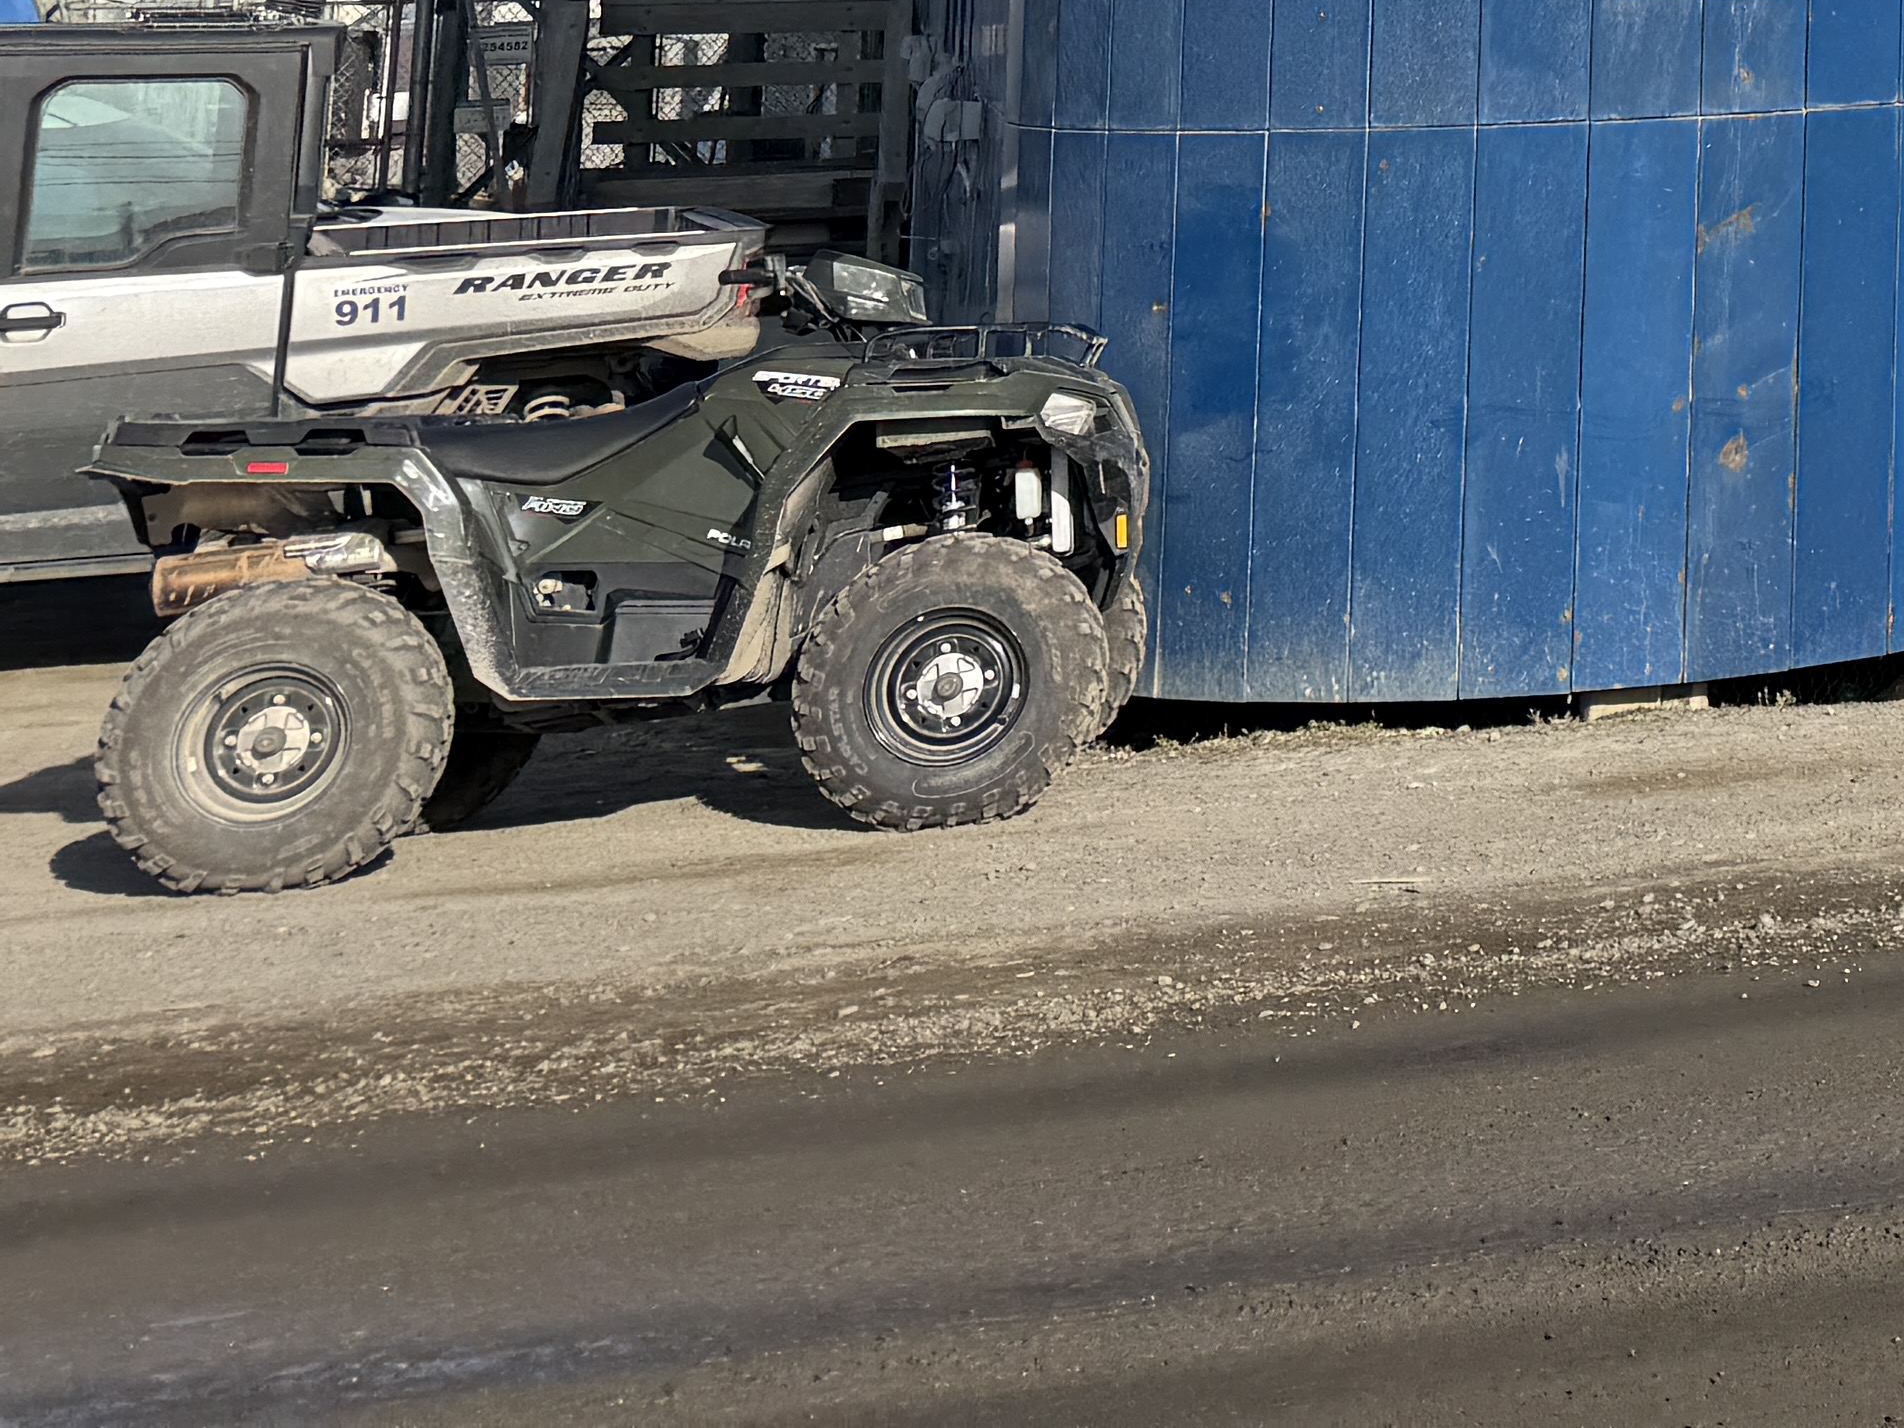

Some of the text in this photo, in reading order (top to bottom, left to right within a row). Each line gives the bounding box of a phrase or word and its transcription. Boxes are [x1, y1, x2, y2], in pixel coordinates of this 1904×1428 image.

[453, 261, 673, 295] RANGER
[623, 281, 676, 293] DUTY
[333, 283, 409, 298] EMERGENCY
[335, 295, 407, 327] 911
[706, 528, 752, 550] POLA
